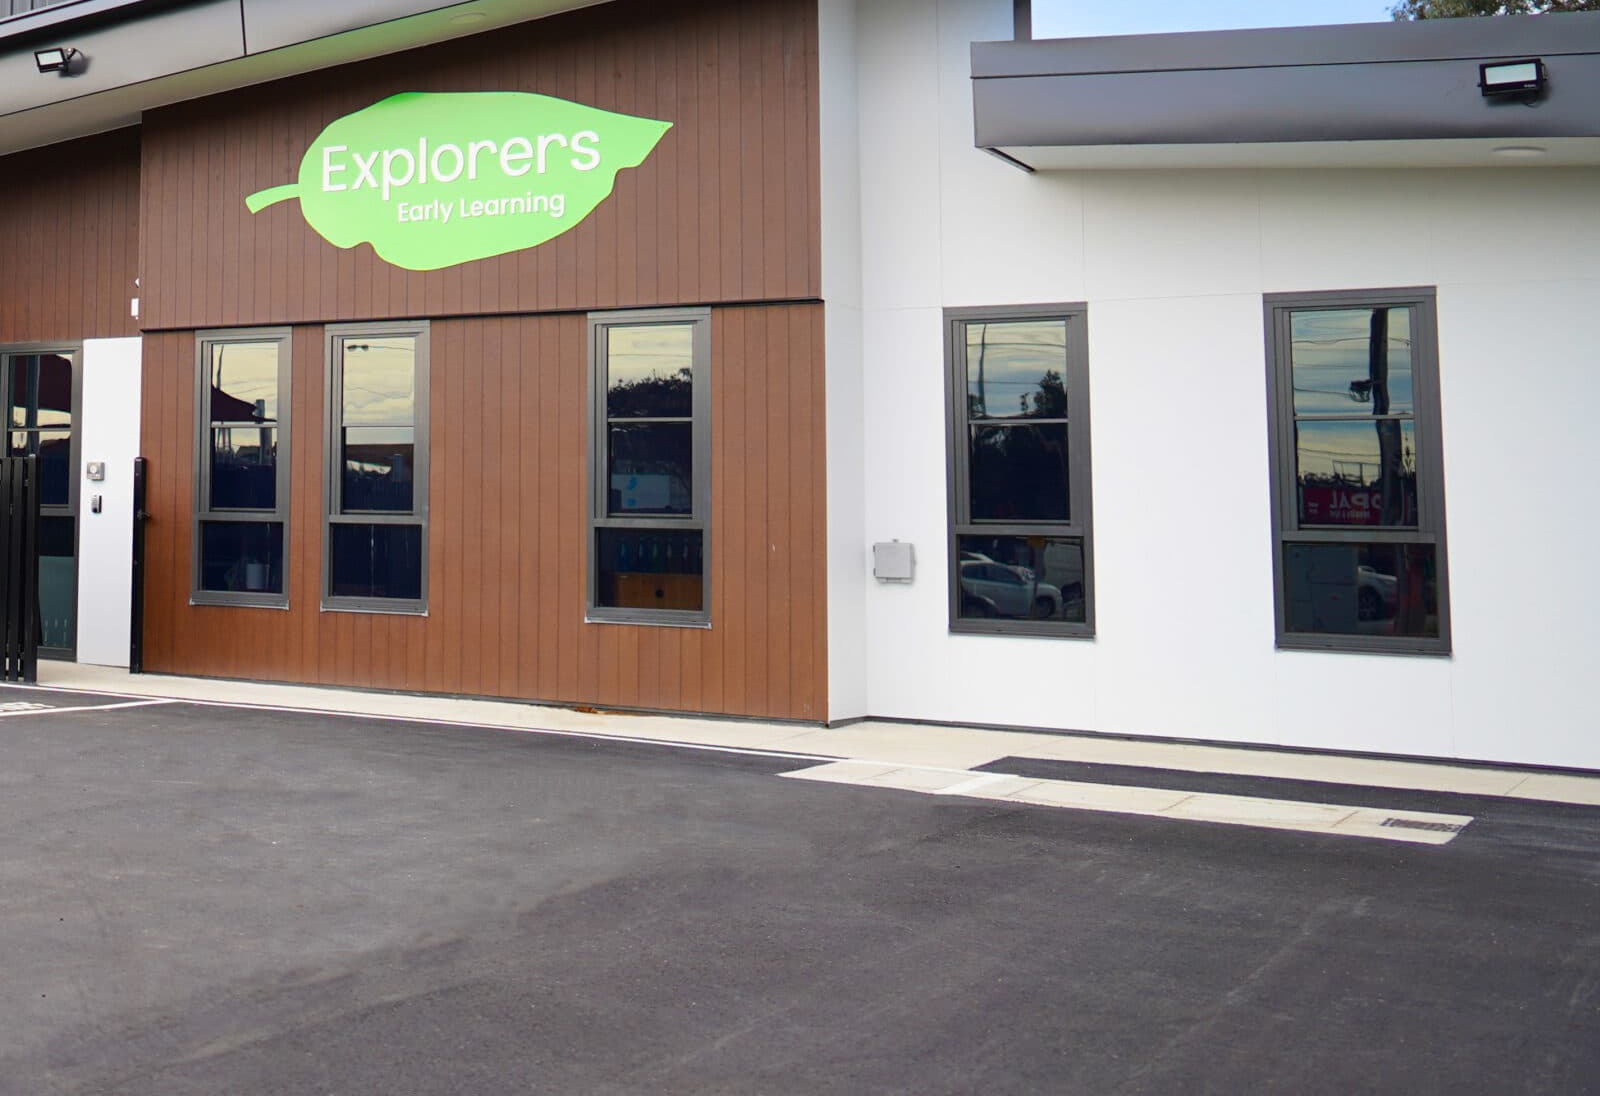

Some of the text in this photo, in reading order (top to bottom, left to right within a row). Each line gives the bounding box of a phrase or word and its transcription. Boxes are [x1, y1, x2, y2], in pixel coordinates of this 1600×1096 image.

[321, 130, 601, 201] Explorers
[398, 191, 566, 224] Early Learning
